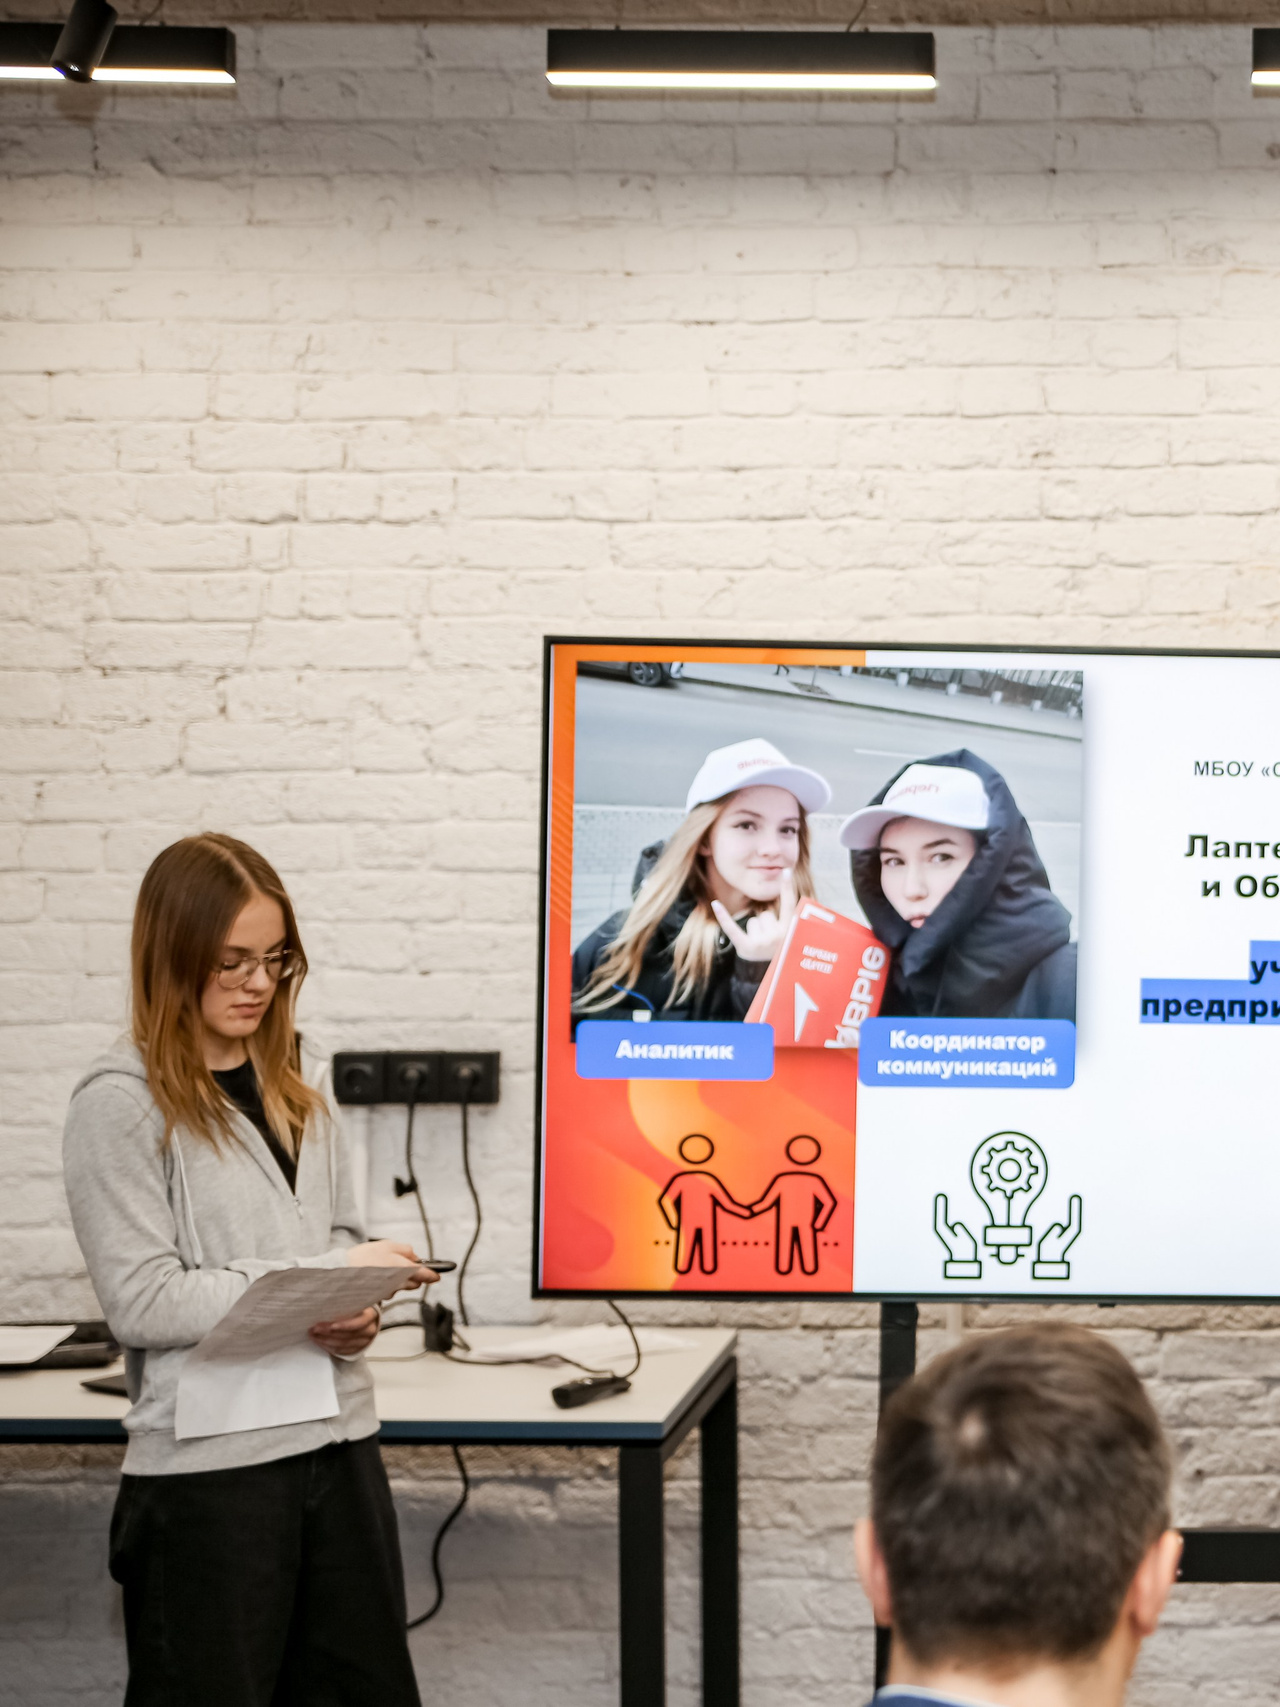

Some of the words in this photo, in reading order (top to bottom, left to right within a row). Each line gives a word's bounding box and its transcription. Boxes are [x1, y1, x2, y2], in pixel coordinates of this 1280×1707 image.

[1193, 760, 1255, 778] МБОУ
[1201, 879, 1222, 898] и
[615, 1039, 735, 1061] Аналитик
[889, 1029, 1047, 1055] Координатор
[876, 1056, 1057, 1079] коммуникаций
